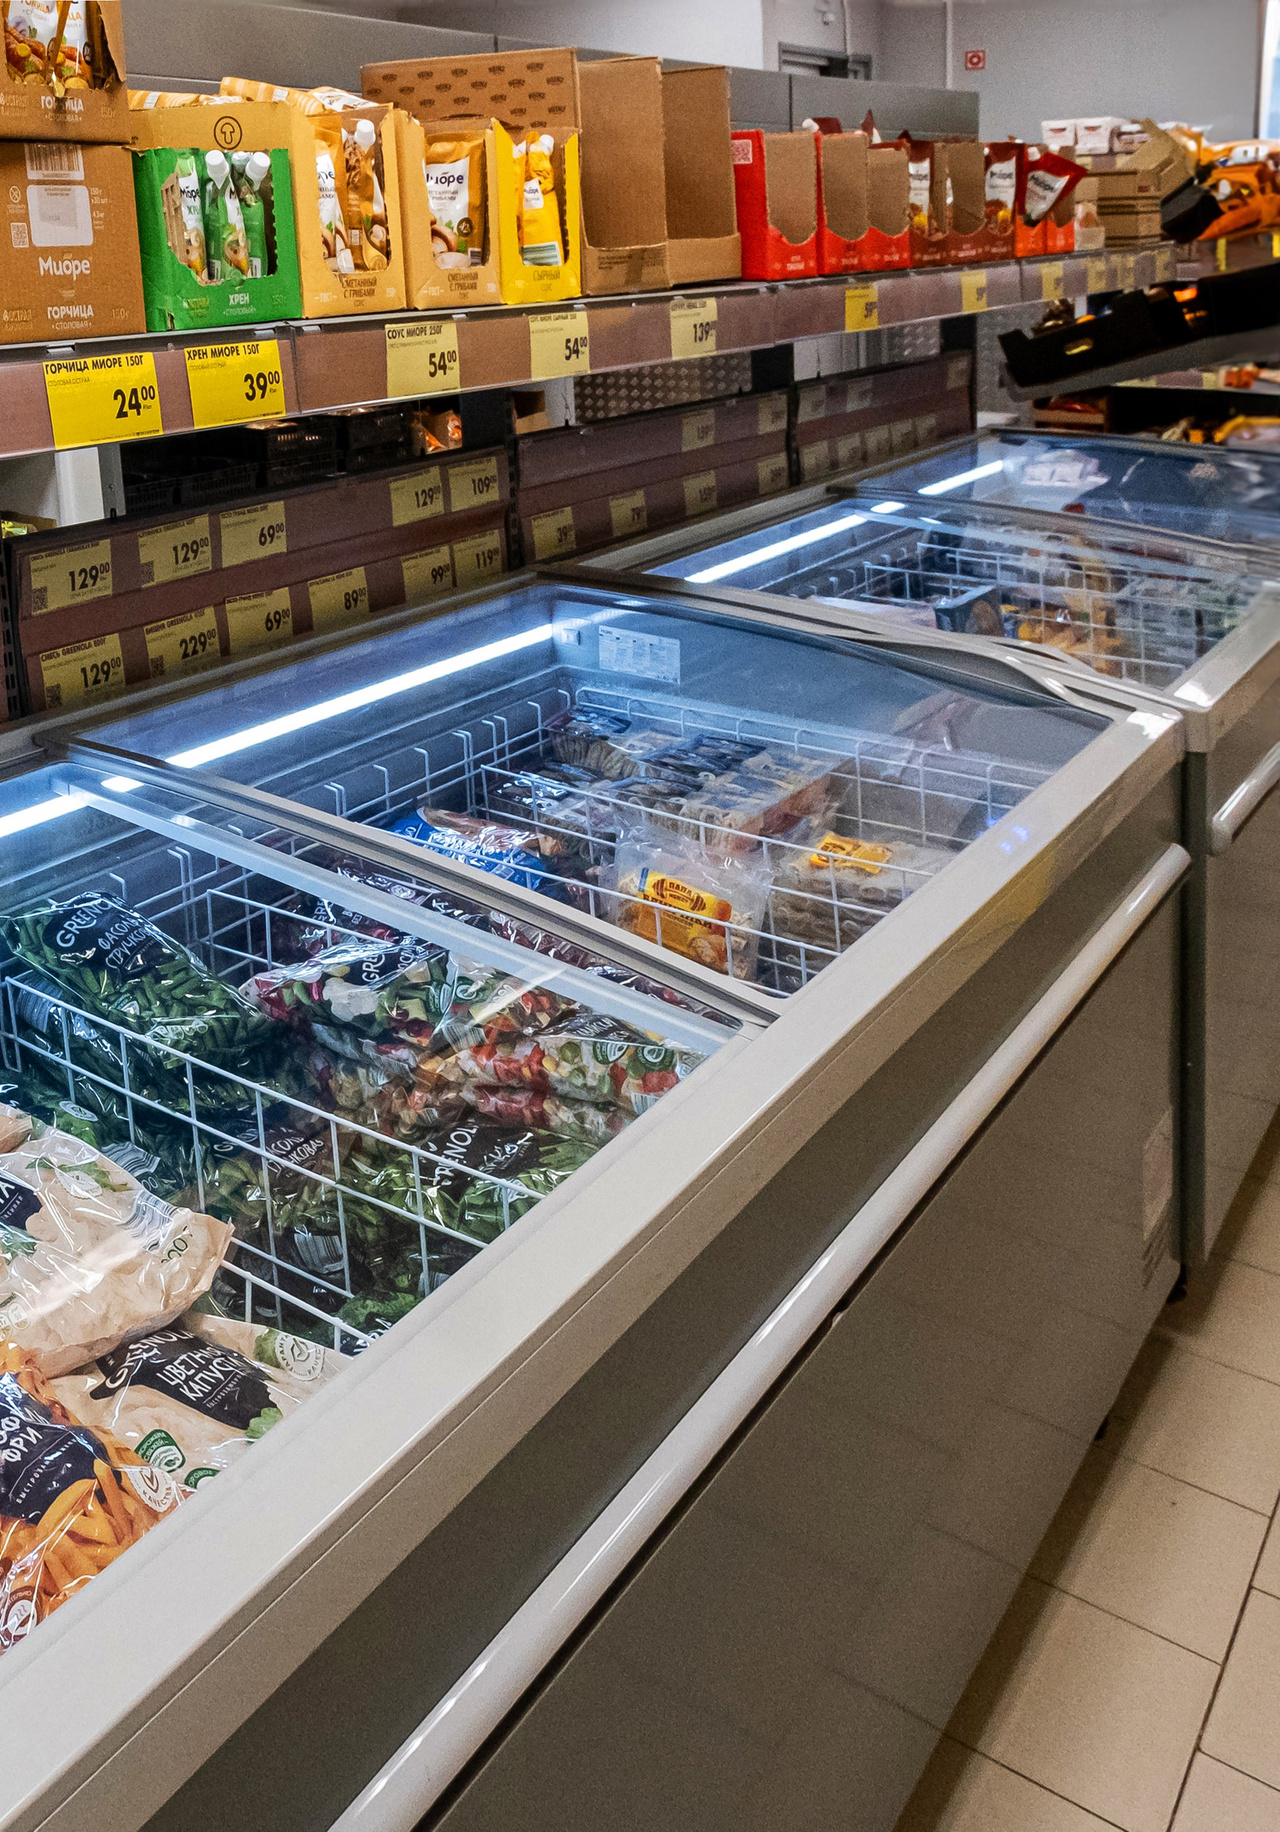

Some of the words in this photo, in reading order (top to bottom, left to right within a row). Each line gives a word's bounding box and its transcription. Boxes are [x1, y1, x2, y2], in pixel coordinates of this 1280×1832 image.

[532, 269, 561, 281] СЫРНЫЙ
[228, 293, 250, 306] ХРЕН
[47, 304, 94, 319] ГОРЧИЦА
[387, 327, 405, 339] СОУС
[406, 326, 427, 338] МИОРЕ
[429, 324, 443, 336] 250Г
[186, 347, 209, 361] ХРЕН
[211, 346, 240, 359] МИОРЕ
[242, 343, 260, 355] 150Г
[45, 359, 89, 376] ГОРЧИЦА
[91, 356, 123, 370] МИОРЕ
[125, 354, 144, 367] 150Г
[41, 651, 61, 663] СМЕСЬ
[62, 642, 92, 657] GREENOLA
[668, 881, 692, 897] ПАПА
